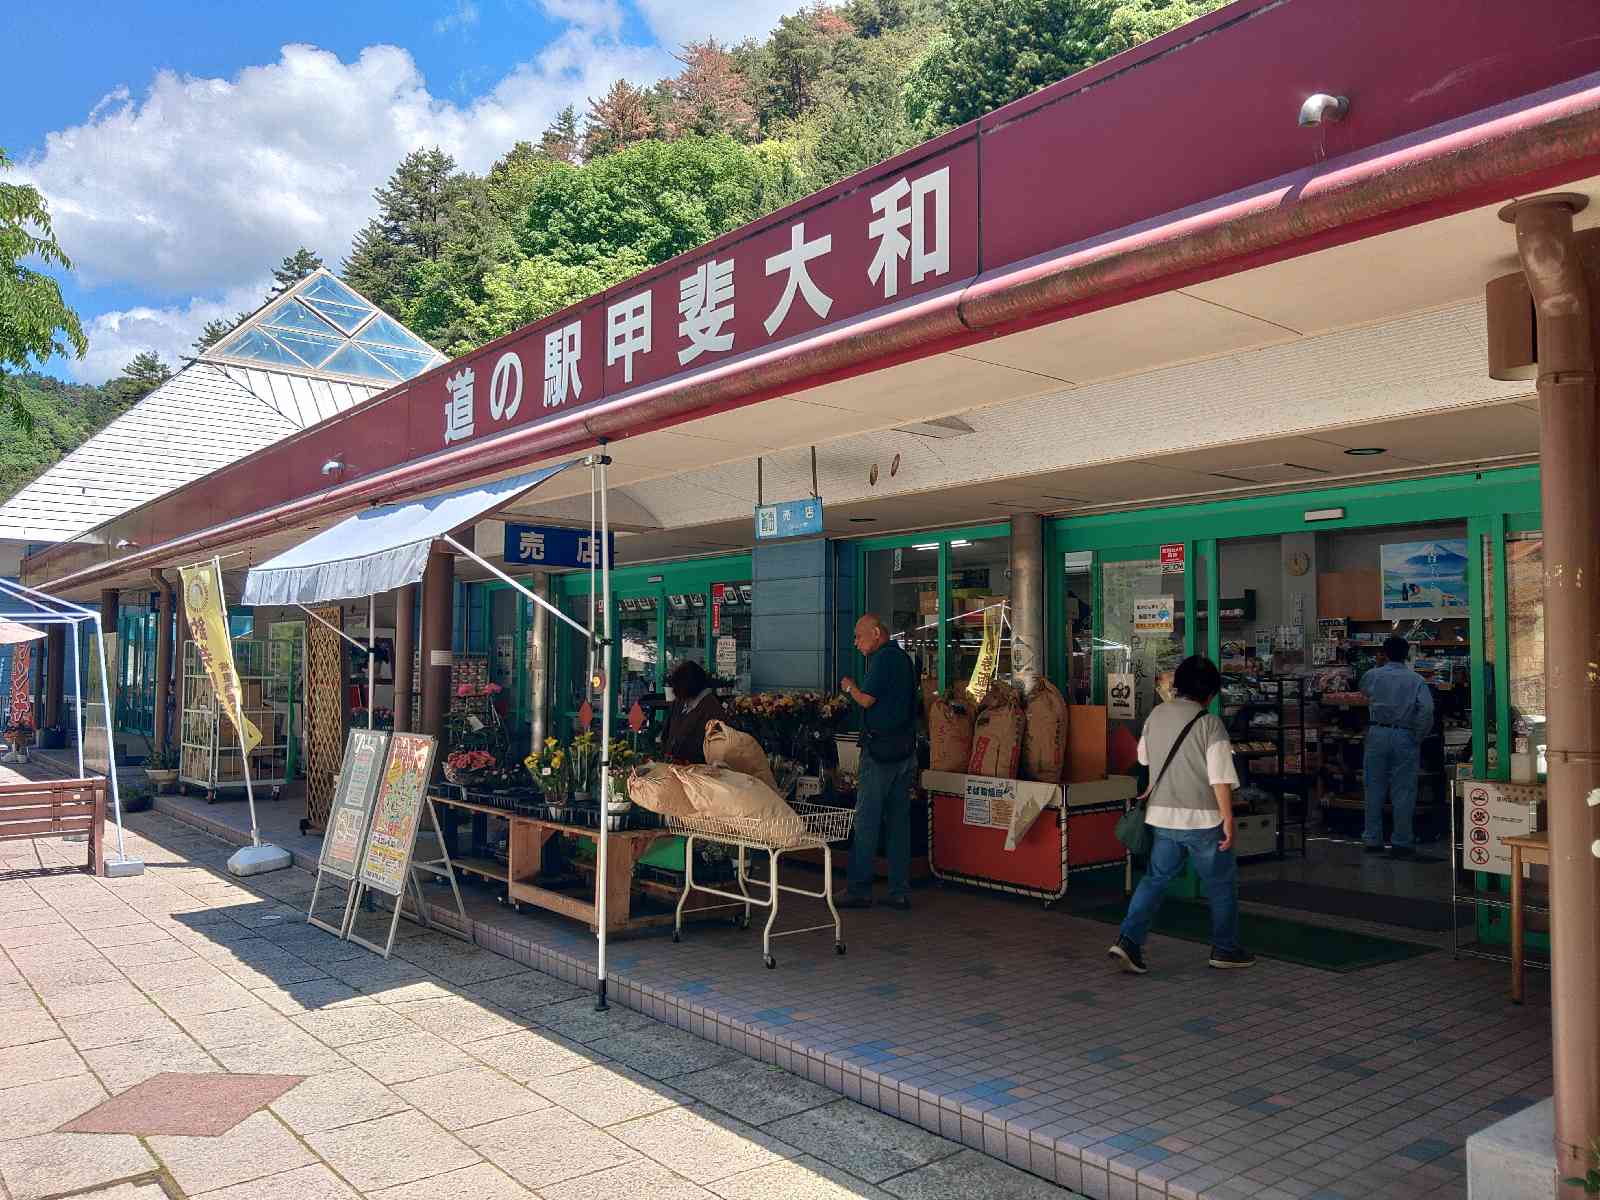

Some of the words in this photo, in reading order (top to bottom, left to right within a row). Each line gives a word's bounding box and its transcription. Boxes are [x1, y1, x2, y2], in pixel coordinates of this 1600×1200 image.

[444, 166, 951, 445] 道の駅甲斐大和
[519, 531, 601, 566] 売店
